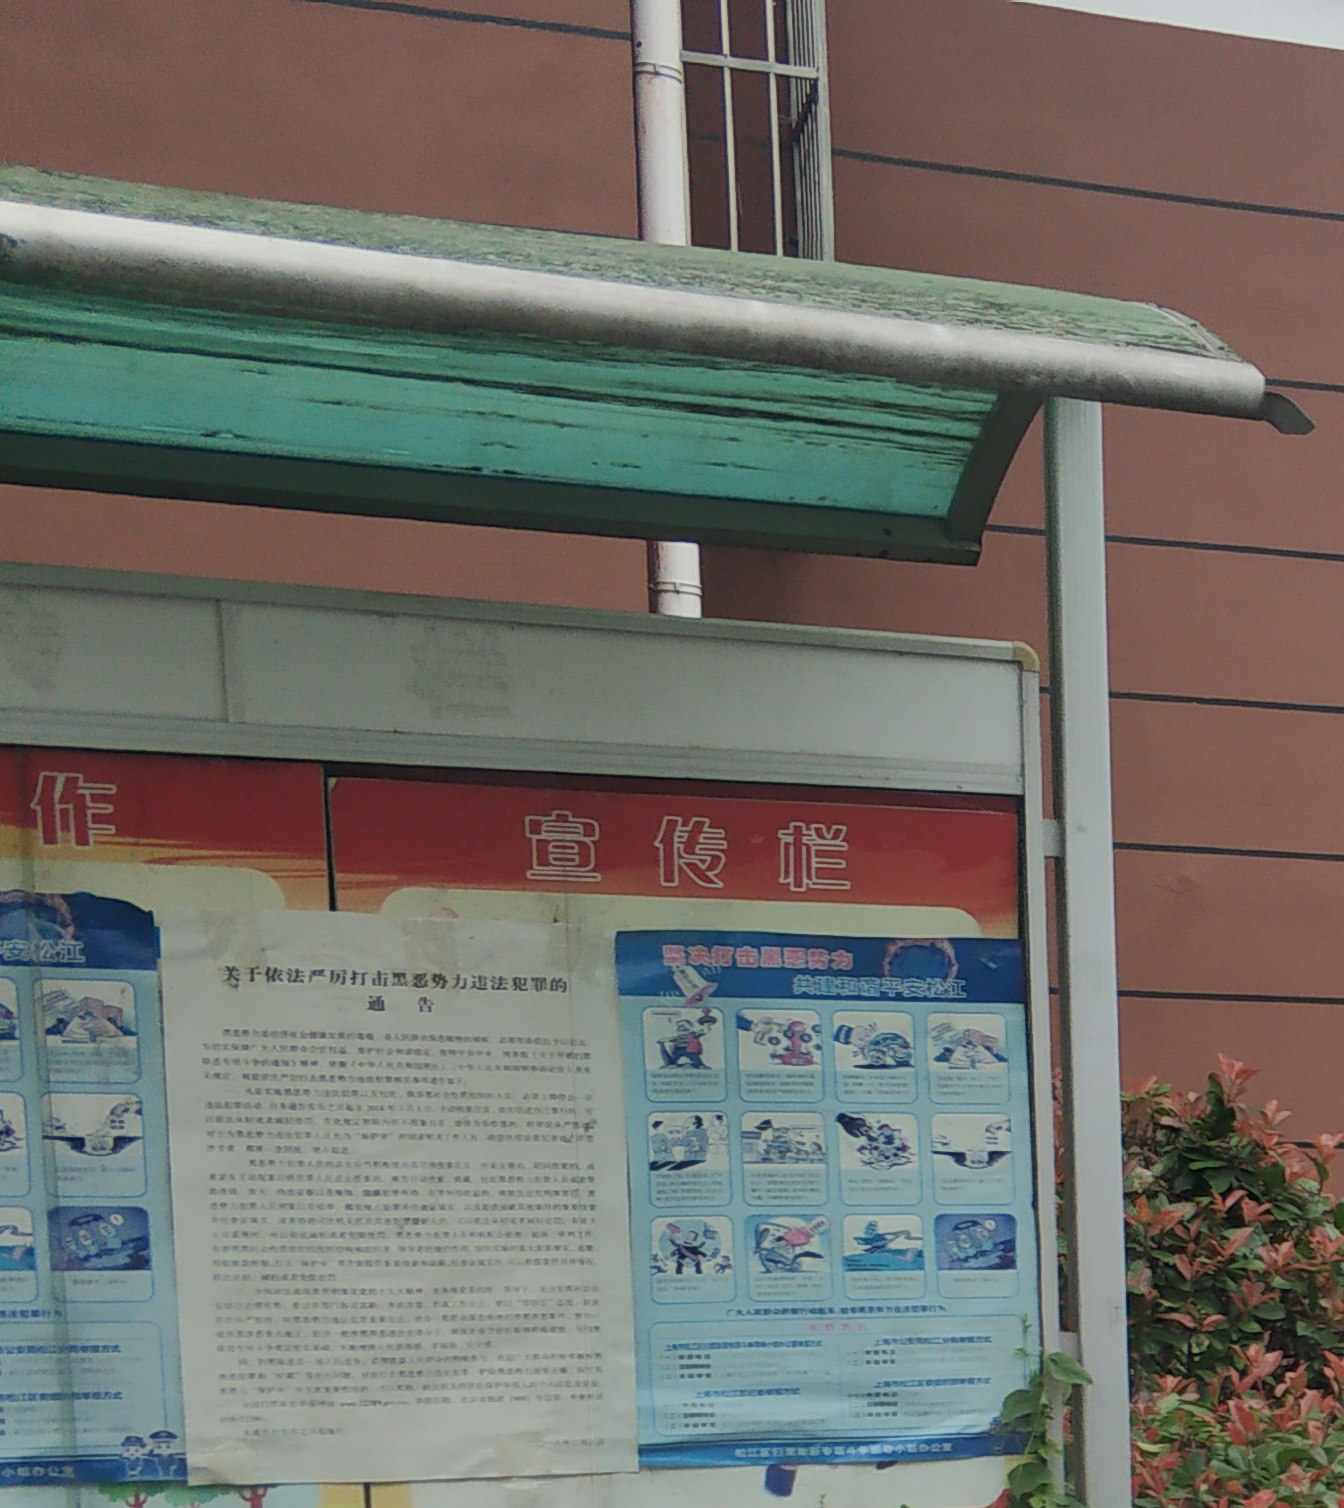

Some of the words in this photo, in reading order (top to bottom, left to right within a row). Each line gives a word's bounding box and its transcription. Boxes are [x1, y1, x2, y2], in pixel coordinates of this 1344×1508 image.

[30, 771, 117, 850] 作
[524, 809, 851, 892] 宣传栏
[661, 944, 854, 971] 坚决打击黑恶势力
[222, 964, 568, 994] 关于依法严厉打击黑恶势力违法犯罪的
[792, 974, 967, 999] 共建和谐平安松江
[365, 994, 436, 1014] 通告
